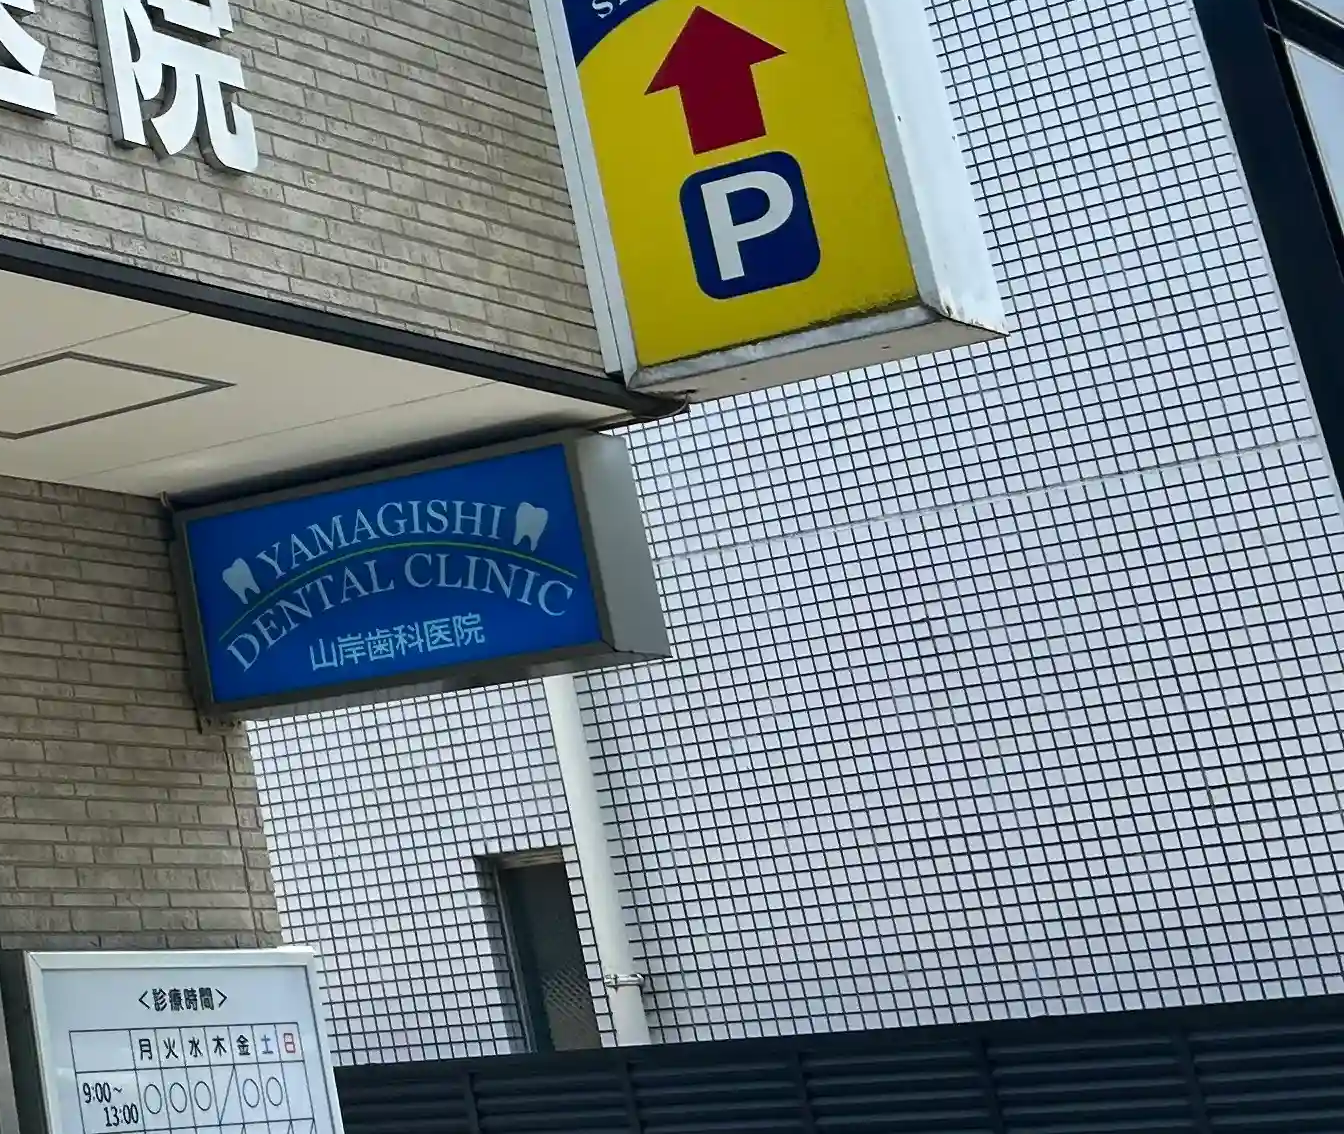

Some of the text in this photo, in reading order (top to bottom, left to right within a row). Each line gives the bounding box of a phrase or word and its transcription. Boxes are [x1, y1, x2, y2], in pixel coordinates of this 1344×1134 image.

[700, 170, 794, 281] P
[255, 498, 507, 581] YAMAGISHI
[226, 552, 574, 672] DENTAL CLINIC
[308, 612, 486, 672] 山岸歯科医院
[138, 1032, 297, 1061] 月 火 水 木 金 土 日
[103, 1103, 140, 1127] 13:00
